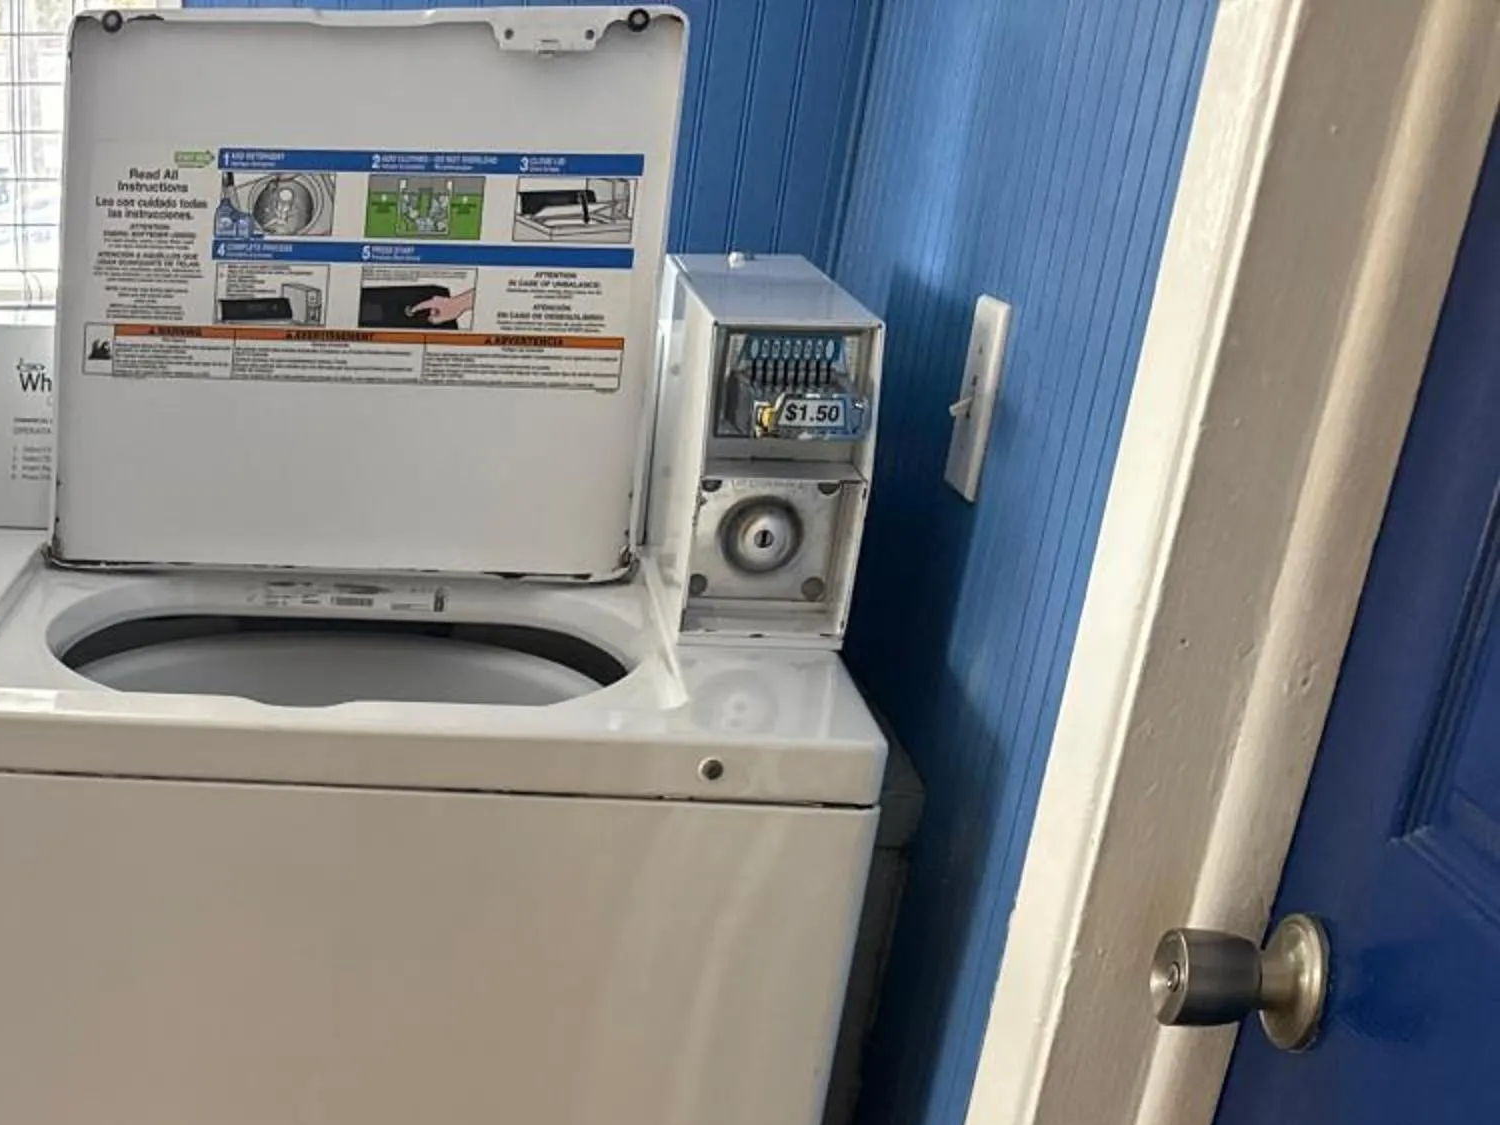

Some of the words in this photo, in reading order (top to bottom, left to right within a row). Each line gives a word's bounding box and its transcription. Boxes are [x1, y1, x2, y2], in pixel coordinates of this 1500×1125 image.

[372, 154, 380, 168] 2
[520, 157, 528, 172] 3
[129, 167, 161, 180] Read
[164, 168, 179, 180] All
[117, 181, 189, 193] Instructions
[137, 198, 177, 209] cuidado
[180, 199, 208, 209] todas
[108, 207, 122, 218] las
[217, 242, 225, 256] 4
[362, 245, 371, 260] 5
[784, 404, 840, 422] $1.50
